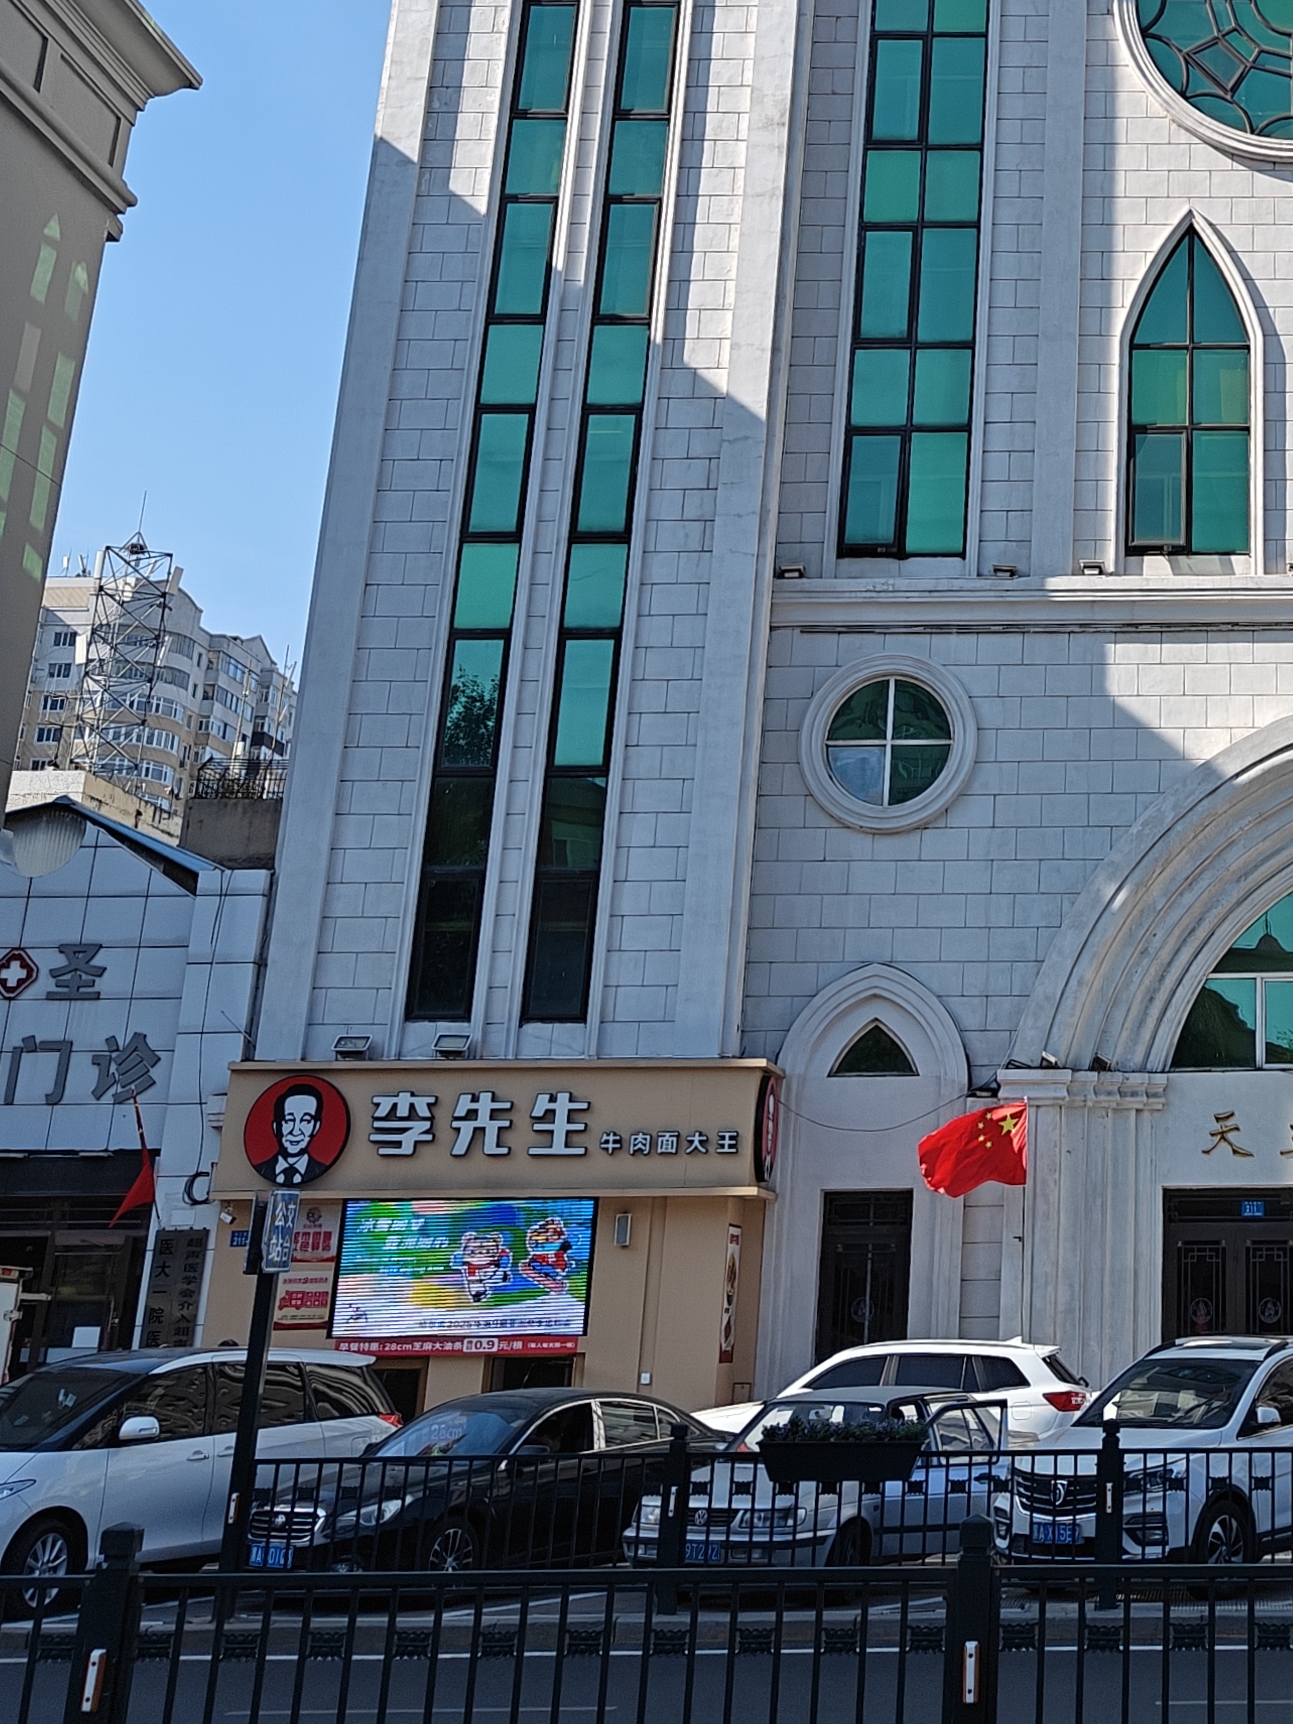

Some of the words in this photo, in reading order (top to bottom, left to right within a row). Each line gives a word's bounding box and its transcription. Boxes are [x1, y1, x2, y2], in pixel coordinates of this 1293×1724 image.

[46, 943, 107, 1001] 圣
[4, 1032, 161, 1105] 门诊
[368, 1090, 592, 1157] 李先生
[600, 1130, 740, 1156] 牛肉面大王
[268, 1225, 291, 1262] 站台
[274, 1200, 296, 1229] 公交
